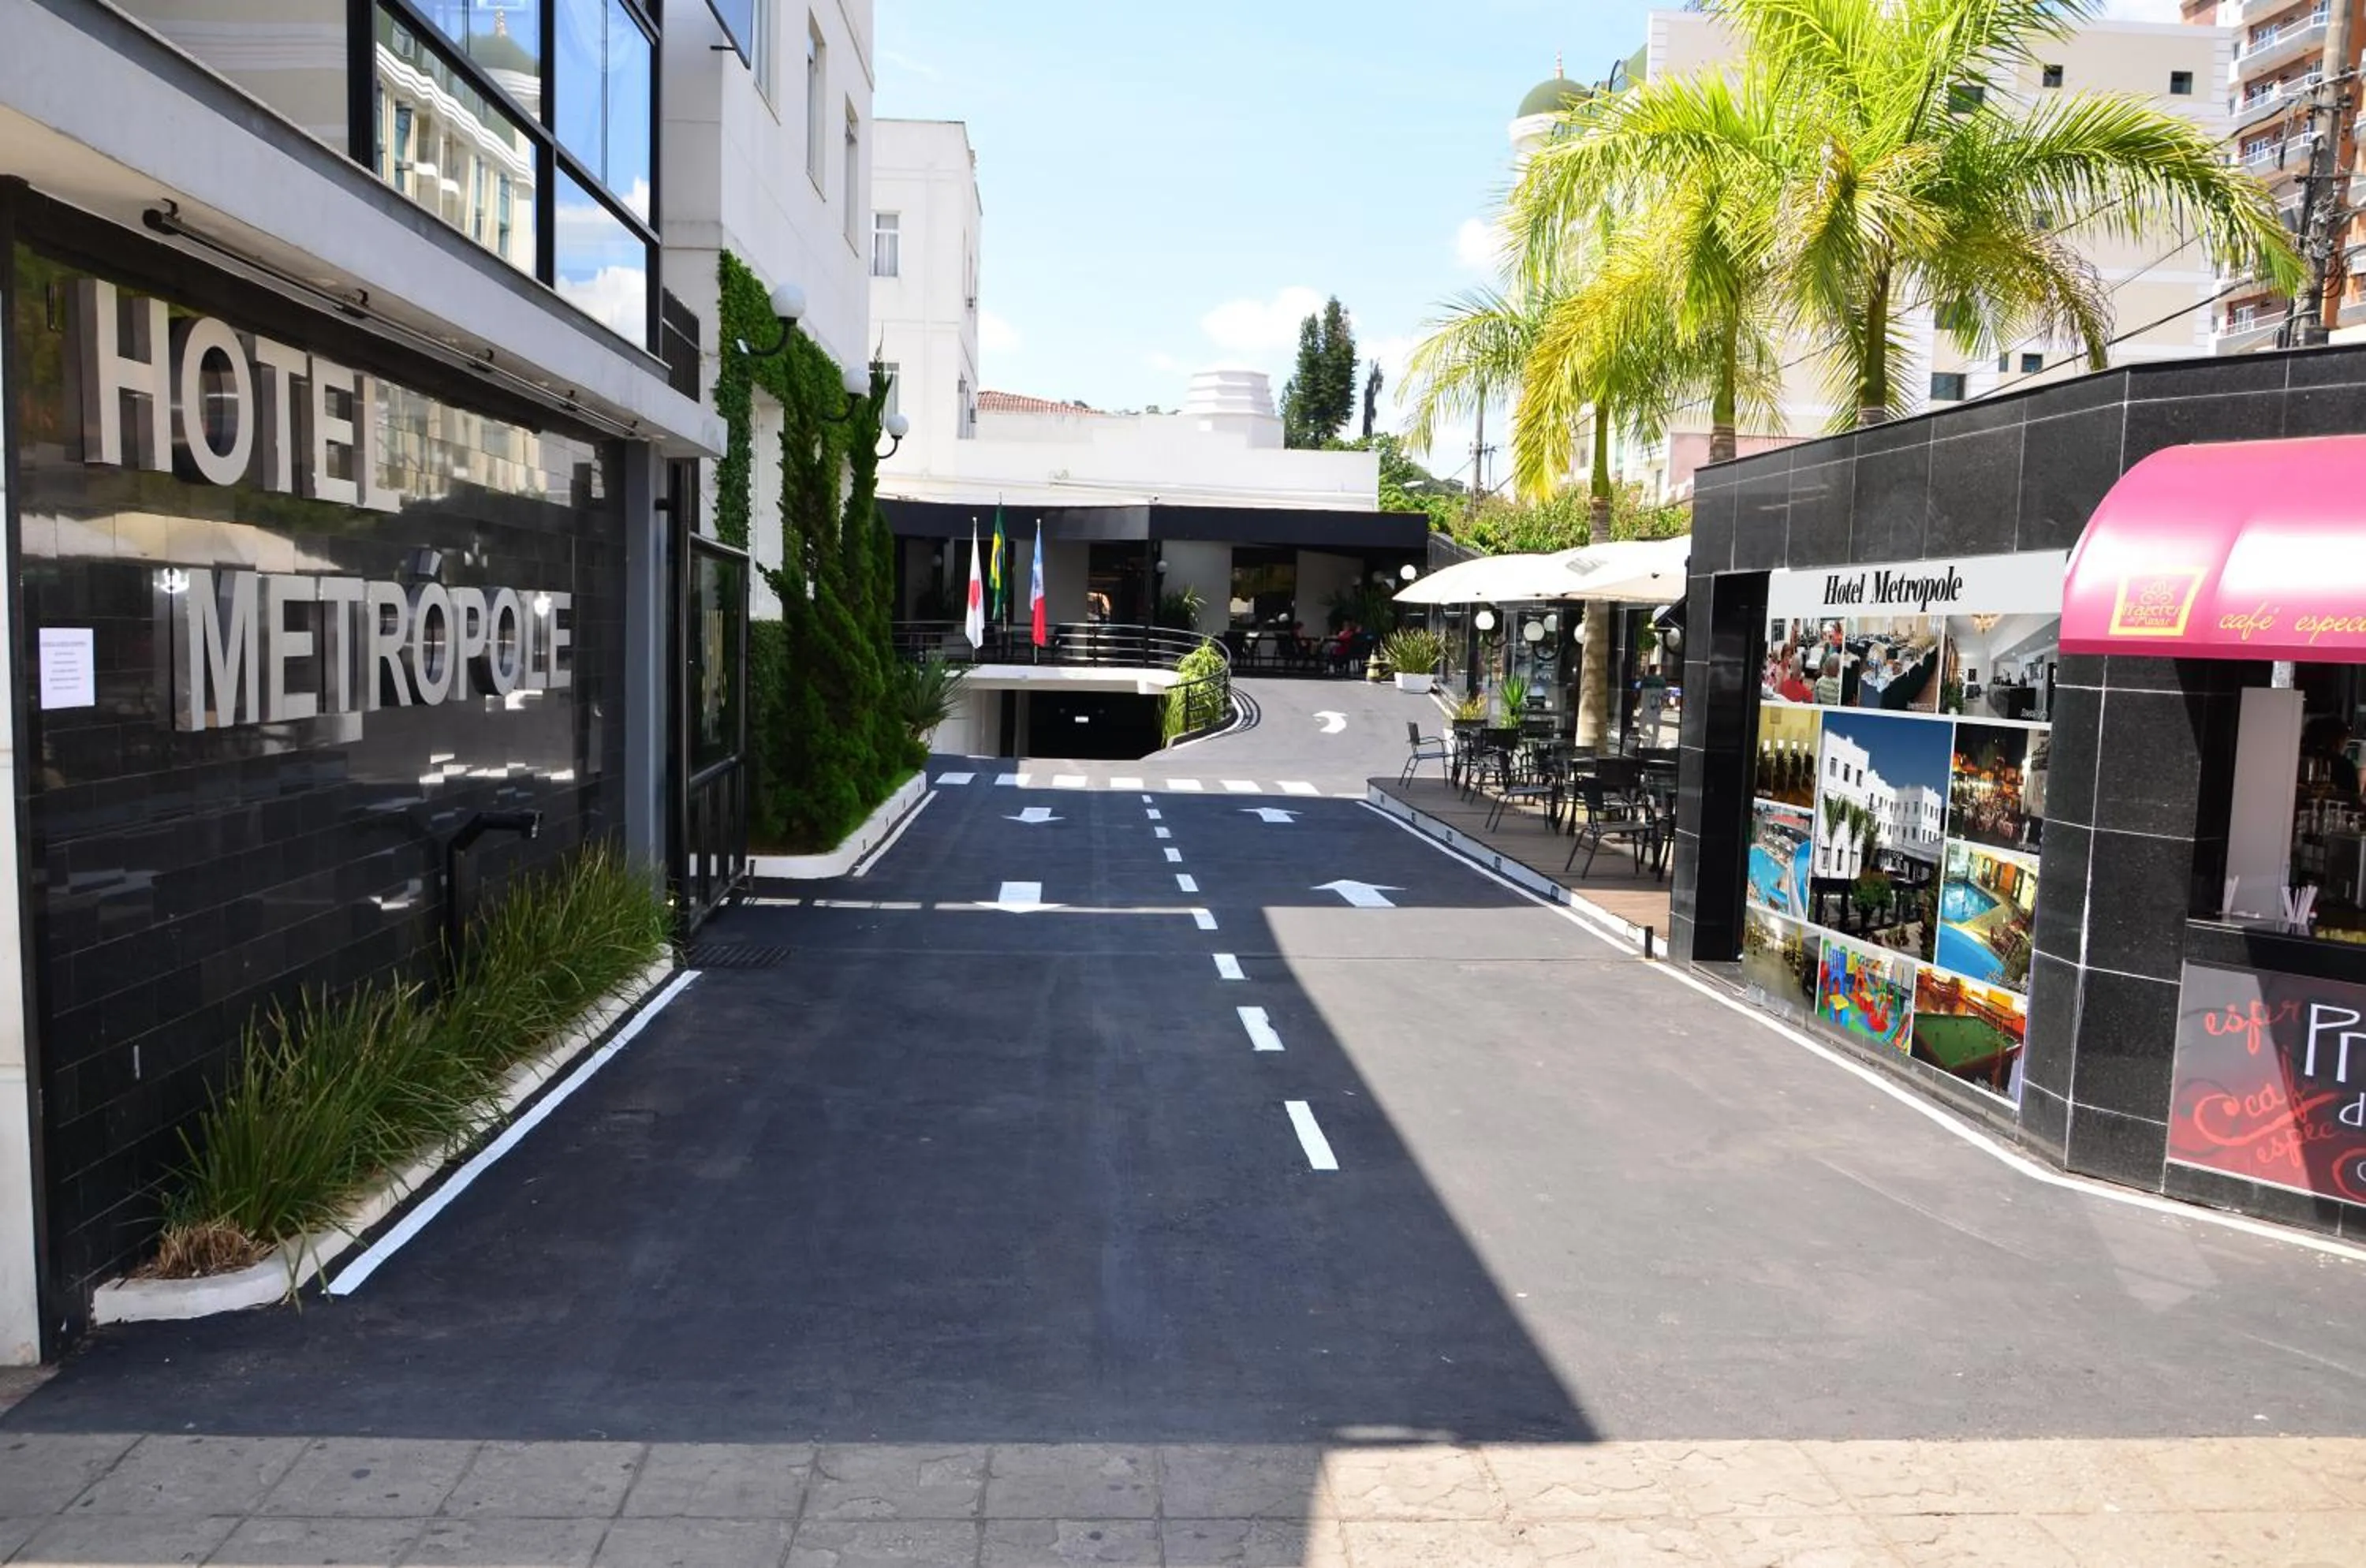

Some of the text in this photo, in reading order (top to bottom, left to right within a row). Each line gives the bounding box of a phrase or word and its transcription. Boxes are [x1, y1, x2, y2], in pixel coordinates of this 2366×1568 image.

[80, 278, 401, 513] HOTEL
[175, 550, 572, 732] METRÓPOLE
[1823, 566, 1963, 612] Hotel Metropole
[2219, 600, 2281, 641] café
